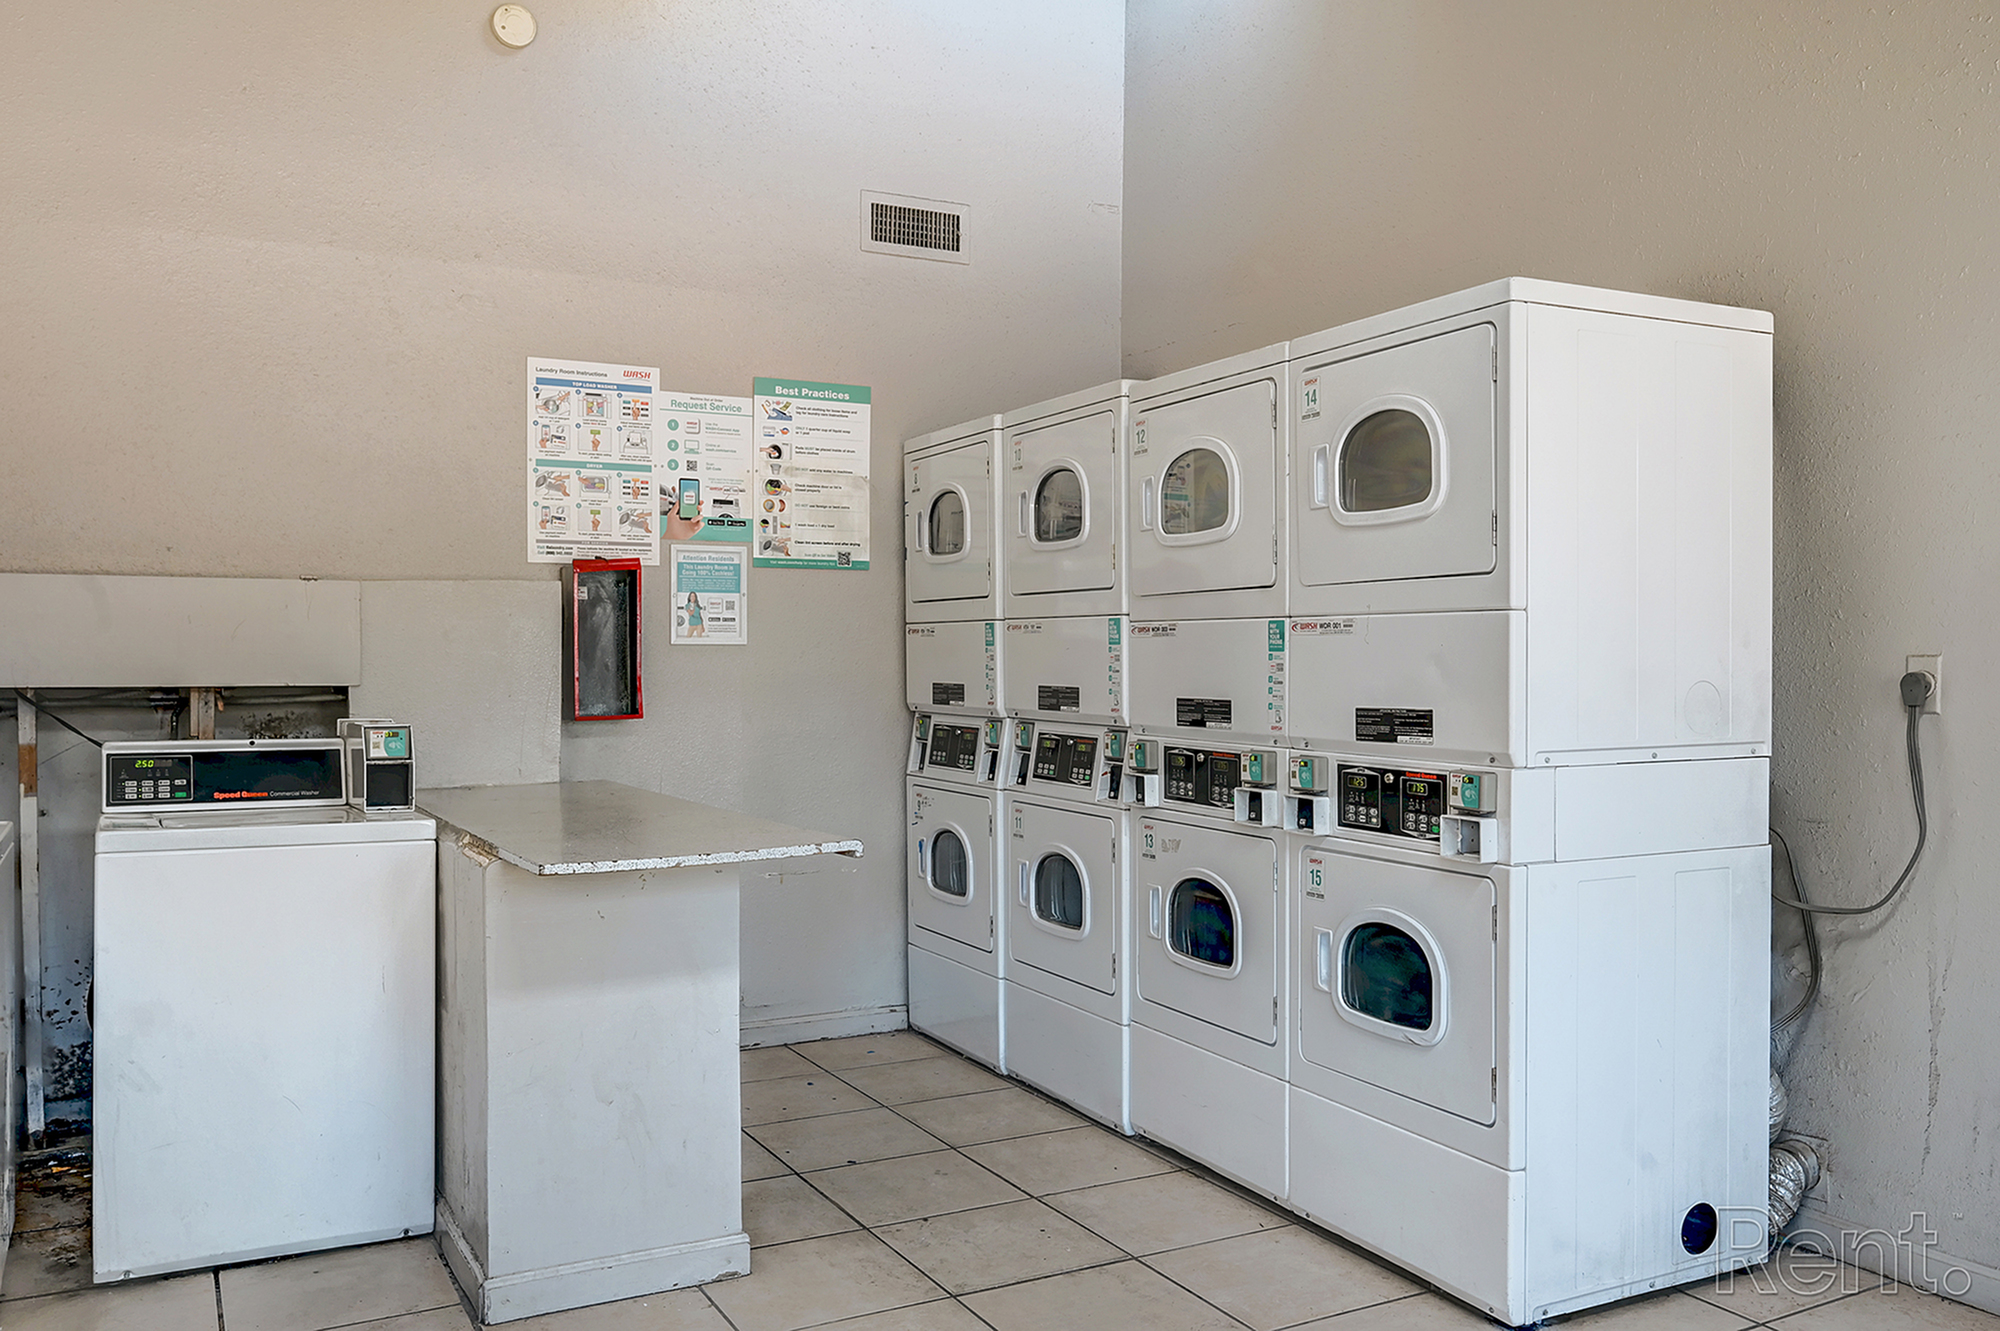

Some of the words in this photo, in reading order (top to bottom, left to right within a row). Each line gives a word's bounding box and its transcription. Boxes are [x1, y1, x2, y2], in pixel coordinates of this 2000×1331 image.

[535, 366, 558, 374] Laundry
[576, 370, 608, 378] Instructions
[622, 370, 651, 379] WASH
[775, 385, 799, 396] Best
[801, 388, 850, 400] Practices
[1304, 388, 1318, 407] 14
[670, 399, 707, 410] Request
[709, 402, 742, 413] Service
[1135, 428, 1146, 445] 12
[1014, 448, 1022, 461] 10
[213, 790, 241, 800] Speed
[241, 790, 269, 798] Queen
[269, 790, 300, 798] Commercial
[1014, 816, 1022, 829] 11
[1144, 833, 1154, 849] 13
[1309, 868, 1322, 887] 15
